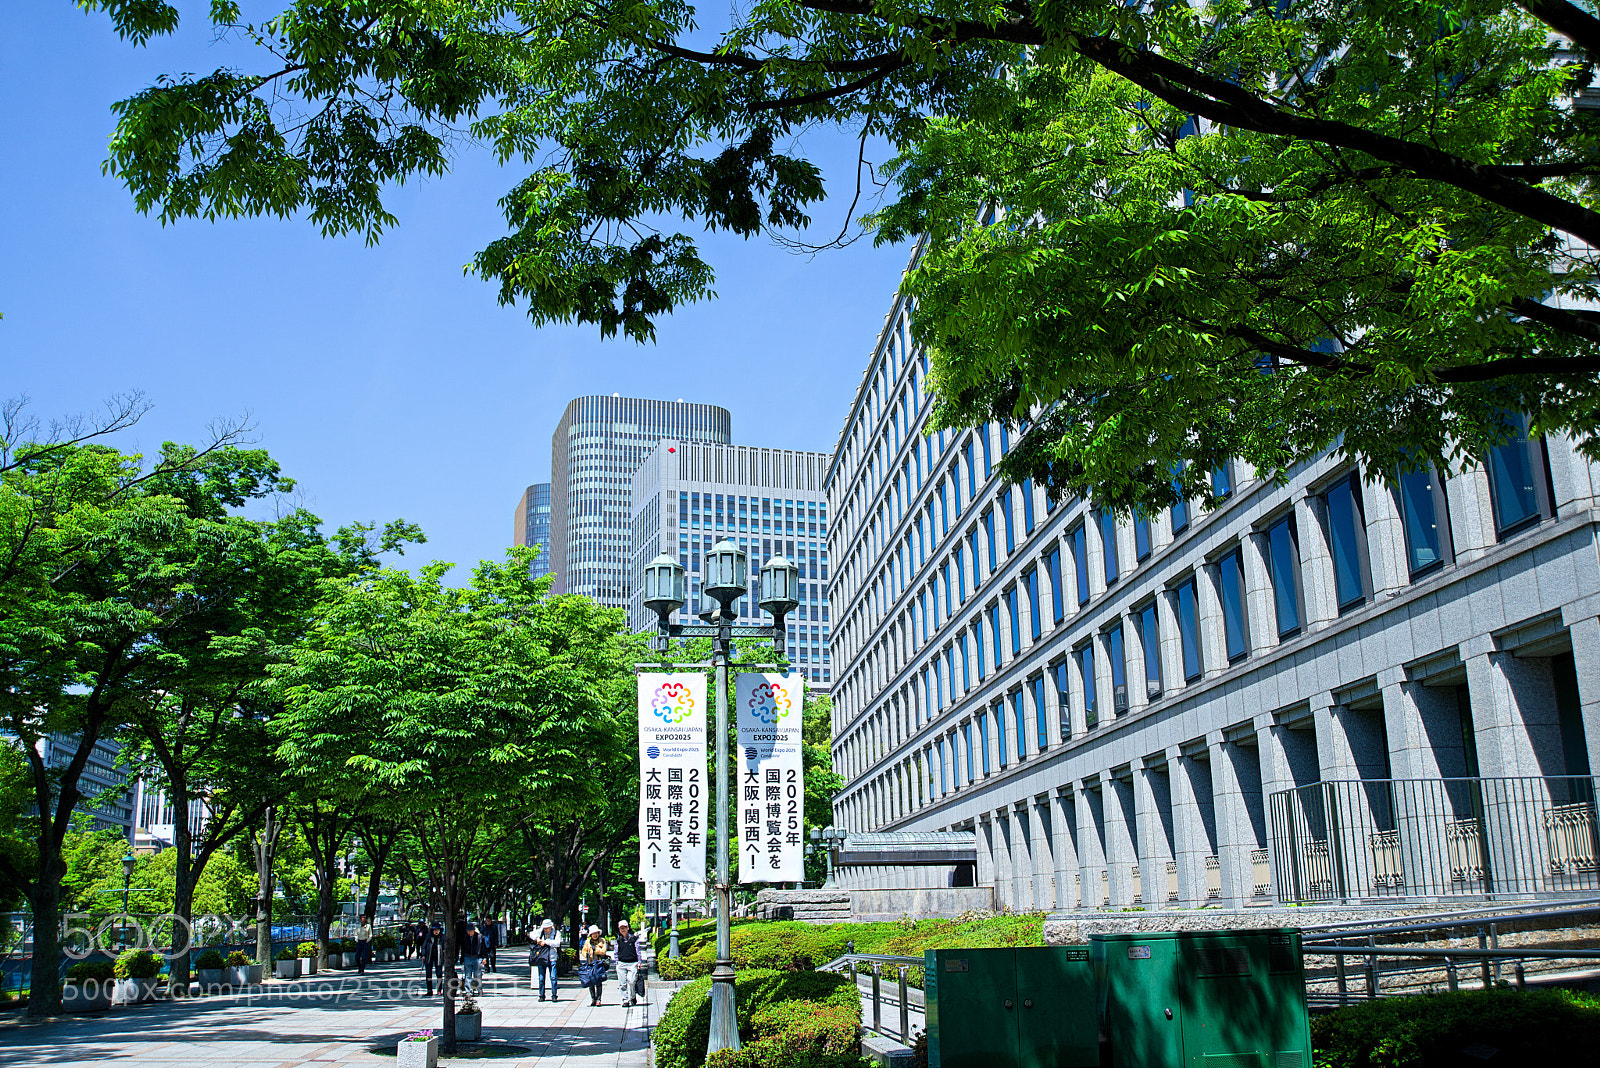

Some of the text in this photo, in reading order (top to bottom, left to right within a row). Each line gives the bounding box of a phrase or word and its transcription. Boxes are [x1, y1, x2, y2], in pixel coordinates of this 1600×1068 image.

[667, 767, 683, 869] 国際博覧会を
[686, 768, 701, 847] 2025年
[765, 768, 782, 869] 国際博覧会を
[785, 769, 801, 847] 2025年
